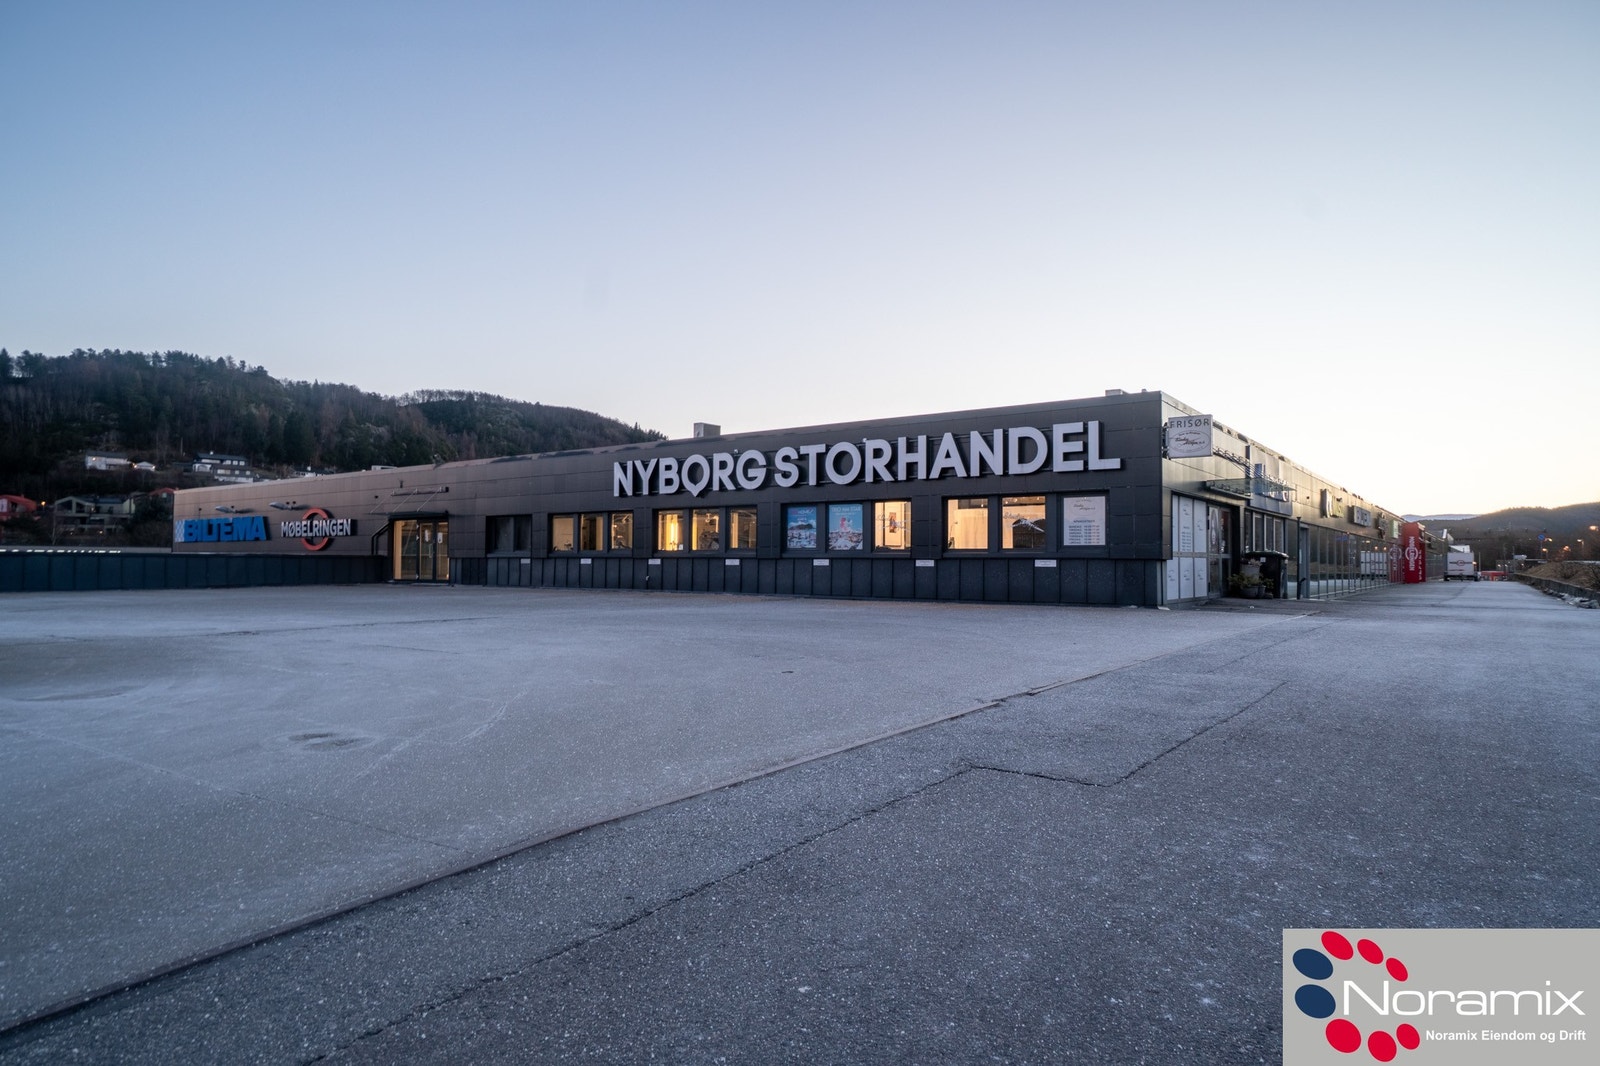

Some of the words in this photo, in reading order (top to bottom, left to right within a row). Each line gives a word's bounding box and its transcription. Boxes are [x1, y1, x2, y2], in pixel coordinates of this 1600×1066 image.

[1170, 418, 1210, 428] FRISØR
[613, 449, 767, 497] NYBORG
[774, 420, 1122, 488] STORHANDEL
[182, 515, 267, 542] BILTEMA
[280, 518, 351, 538] MØBELRINGEN
